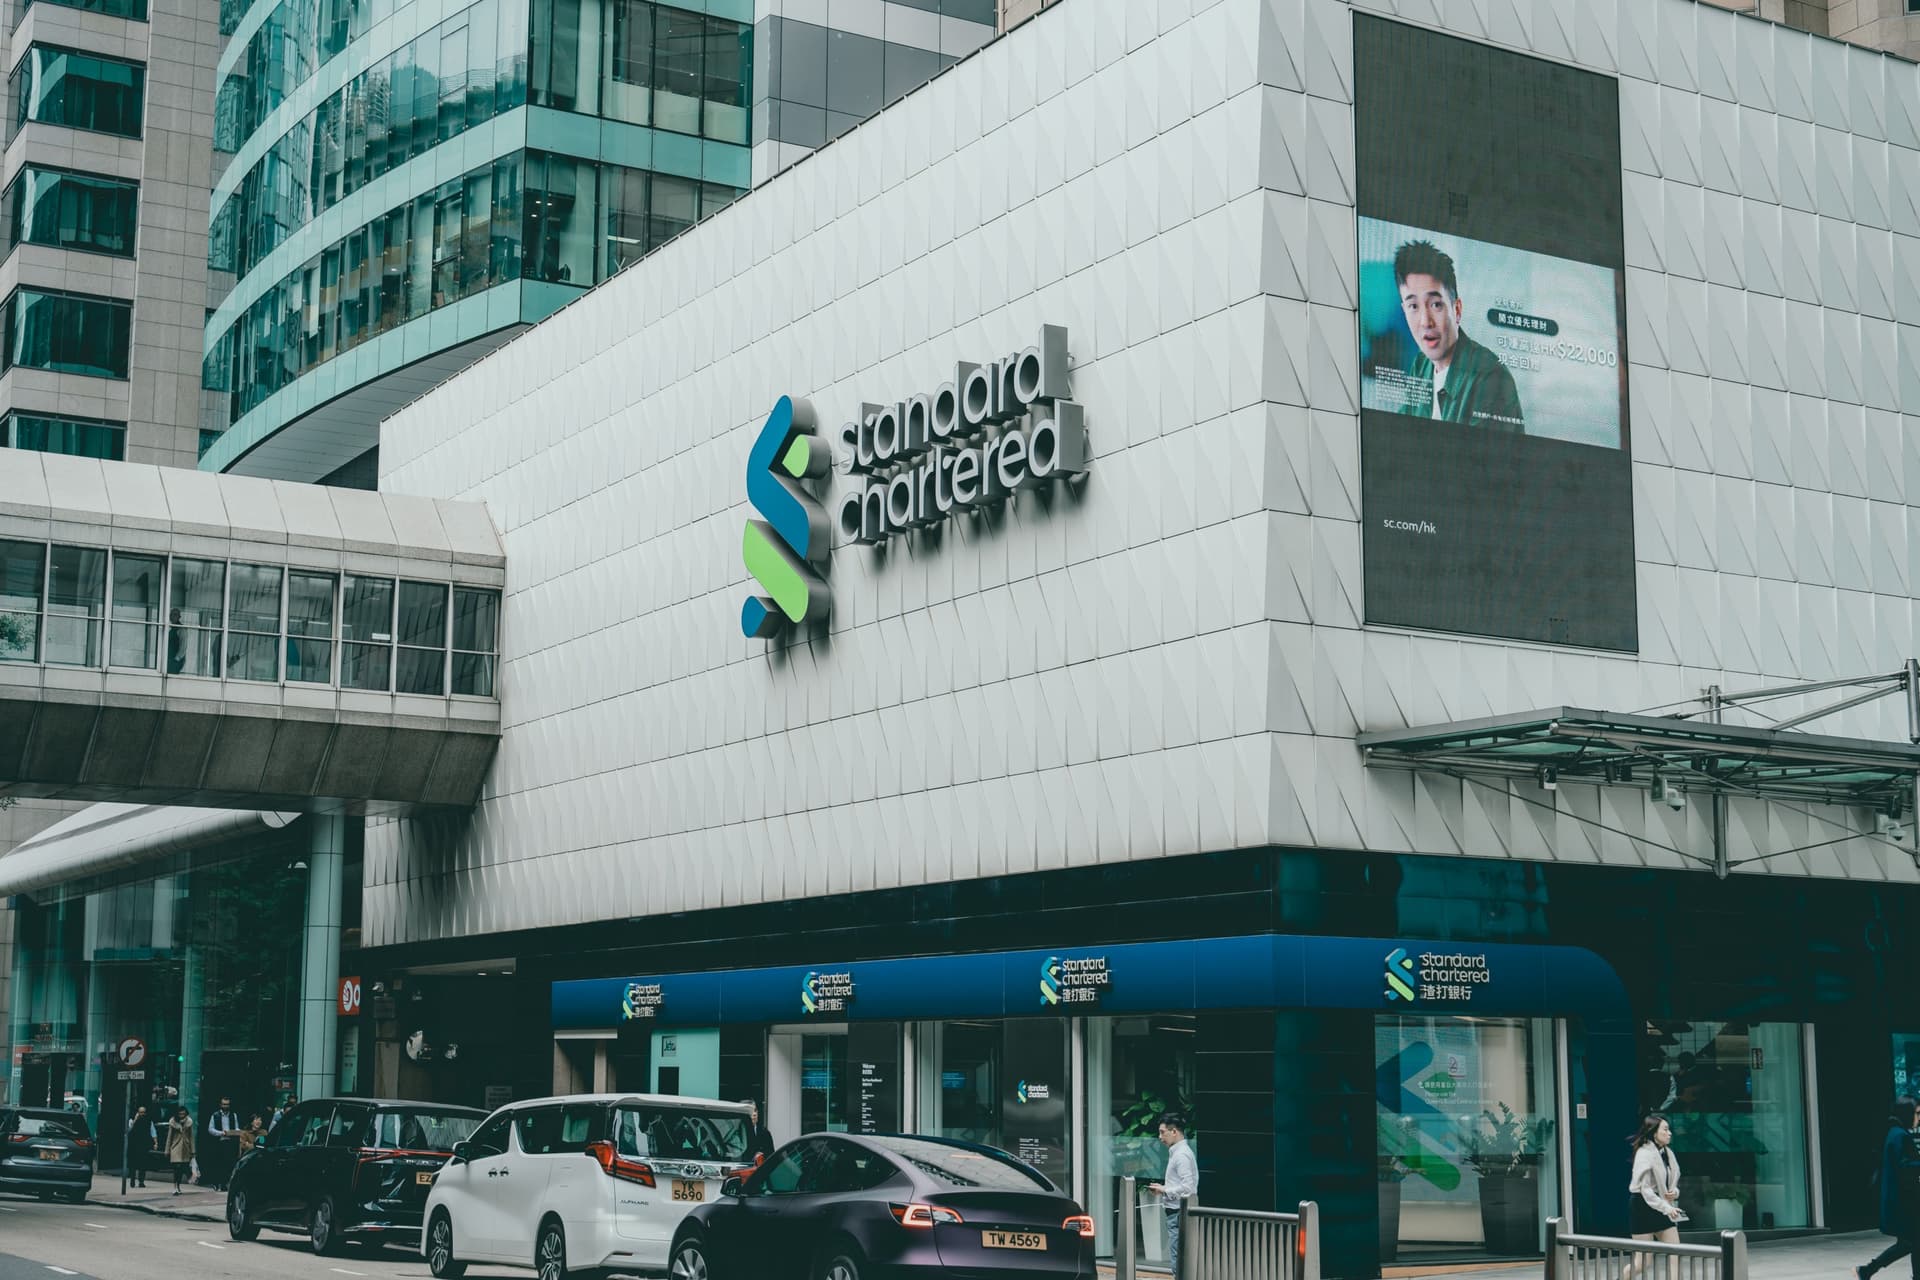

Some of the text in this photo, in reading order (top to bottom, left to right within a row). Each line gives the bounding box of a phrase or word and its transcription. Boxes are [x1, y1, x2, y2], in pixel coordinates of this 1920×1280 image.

[839, 324, 1067, 475] standard
[839, 399, 1083, 544] chartered
[1383, 519, 1436, 534] sc.com/hk
[1062, 956, 1105, 971] standard
[1420, 952, 1486, 968] standard
[818, 971, 850, 984] standard
[1062, 971, 1108, 985] chartered
[1420, 967, 1490, 983] chartered
[818, 985, 852, 997] chartered
[1062, 988, 1096, 1002] 渣打銀行
[1421, 984, 1472, 1000] 渣打銀行
[681, 1180, 695, 1191] YK
[674, 1191, 703, 1201] 5690
[989, 1233, 1040, 1247] TW 4569
